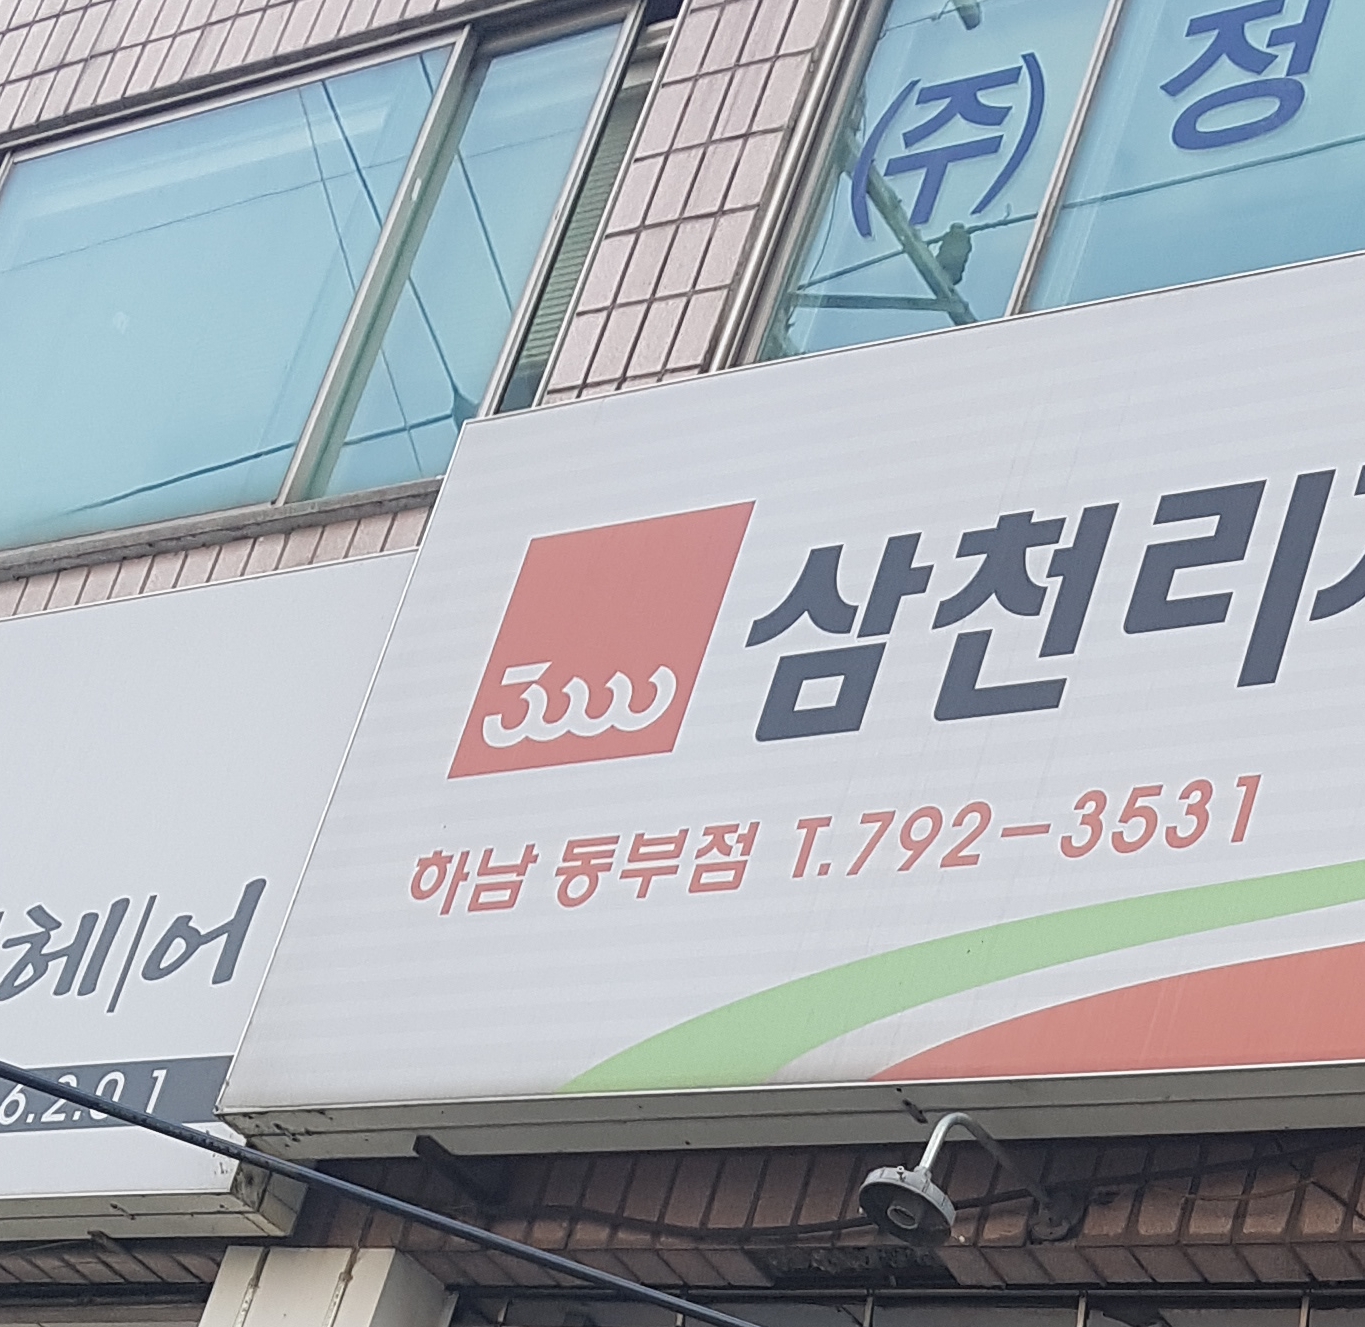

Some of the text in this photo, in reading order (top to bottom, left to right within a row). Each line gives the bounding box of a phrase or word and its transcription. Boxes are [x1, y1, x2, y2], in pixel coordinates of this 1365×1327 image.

[848, 52, 1044, 237] (주)
[409, 773, 1263, 916] 하남 동부점 T.792-3531
